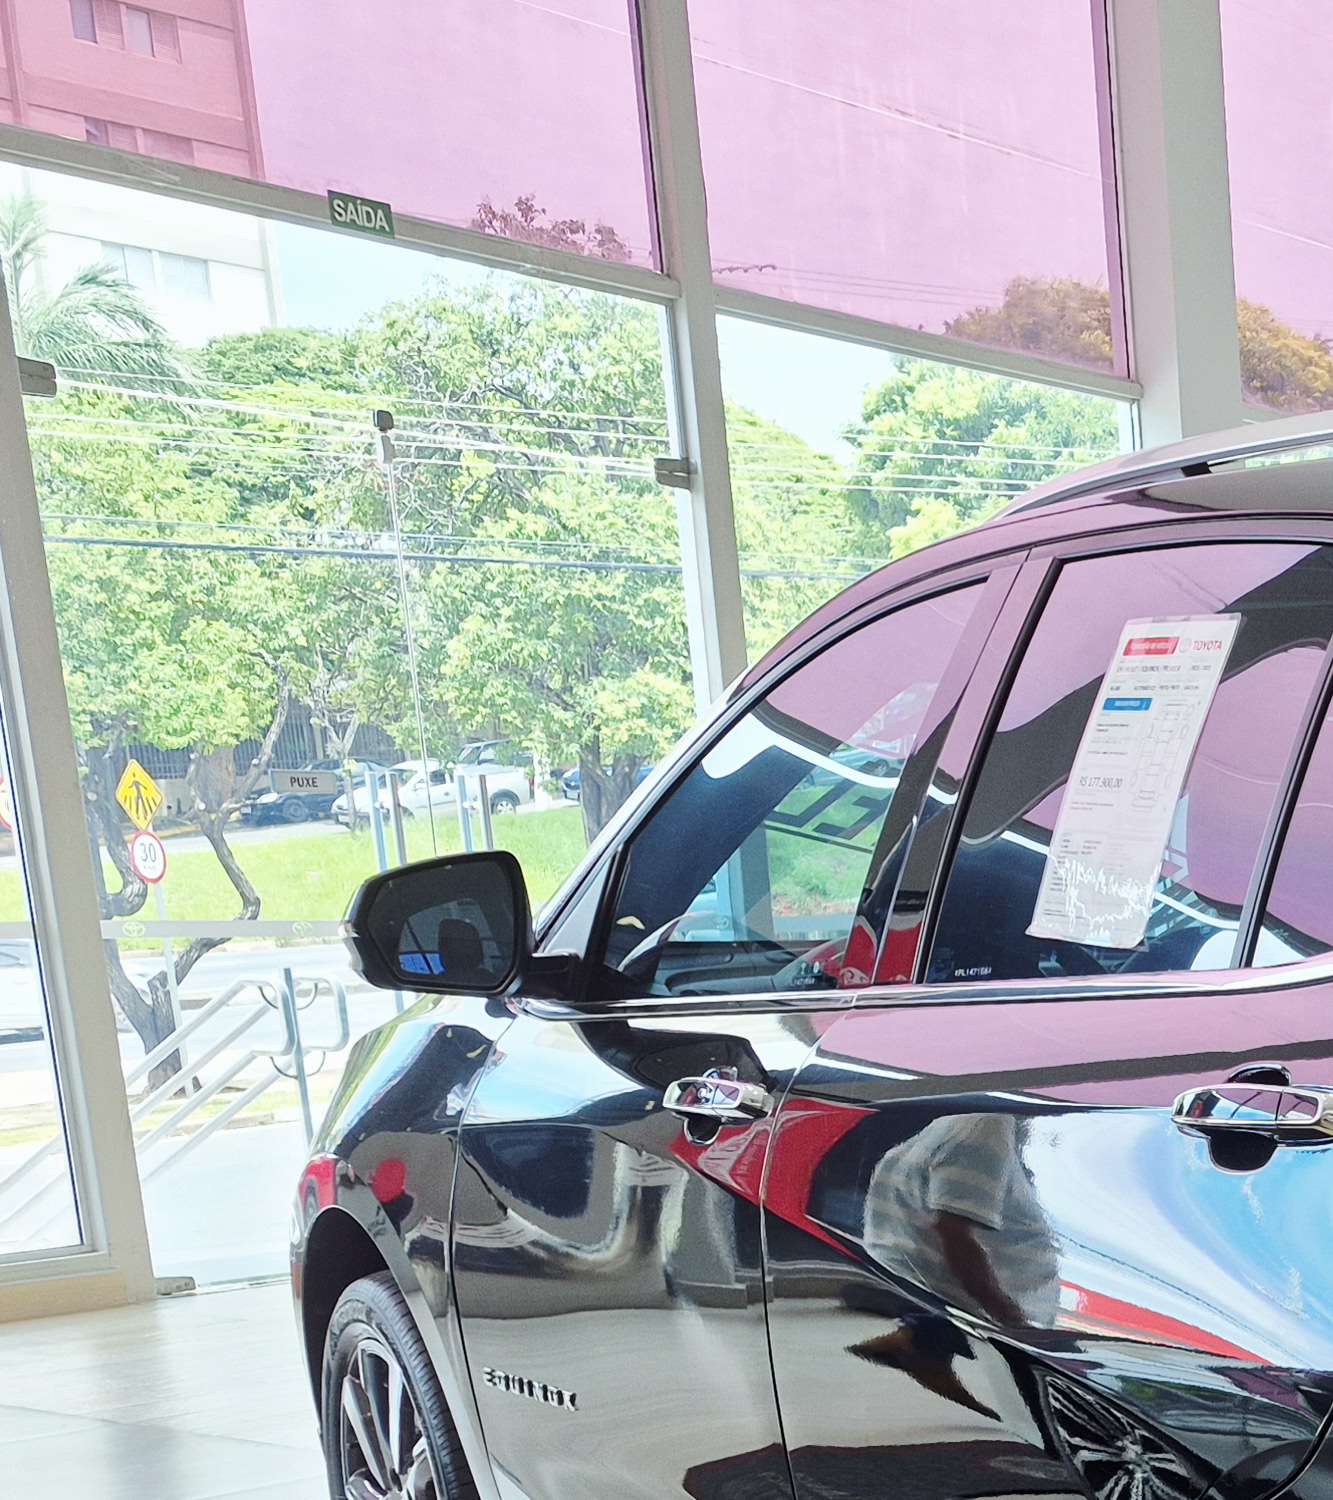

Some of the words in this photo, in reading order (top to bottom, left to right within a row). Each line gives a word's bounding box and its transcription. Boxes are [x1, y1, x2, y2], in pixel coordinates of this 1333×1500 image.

[333, 199, 390, 232] SAÍDA
[1193, 641, 1222, 651] TOYOTA
[290, 776, 318, 788] PUXE
[140, 842, 156, 862] 30
